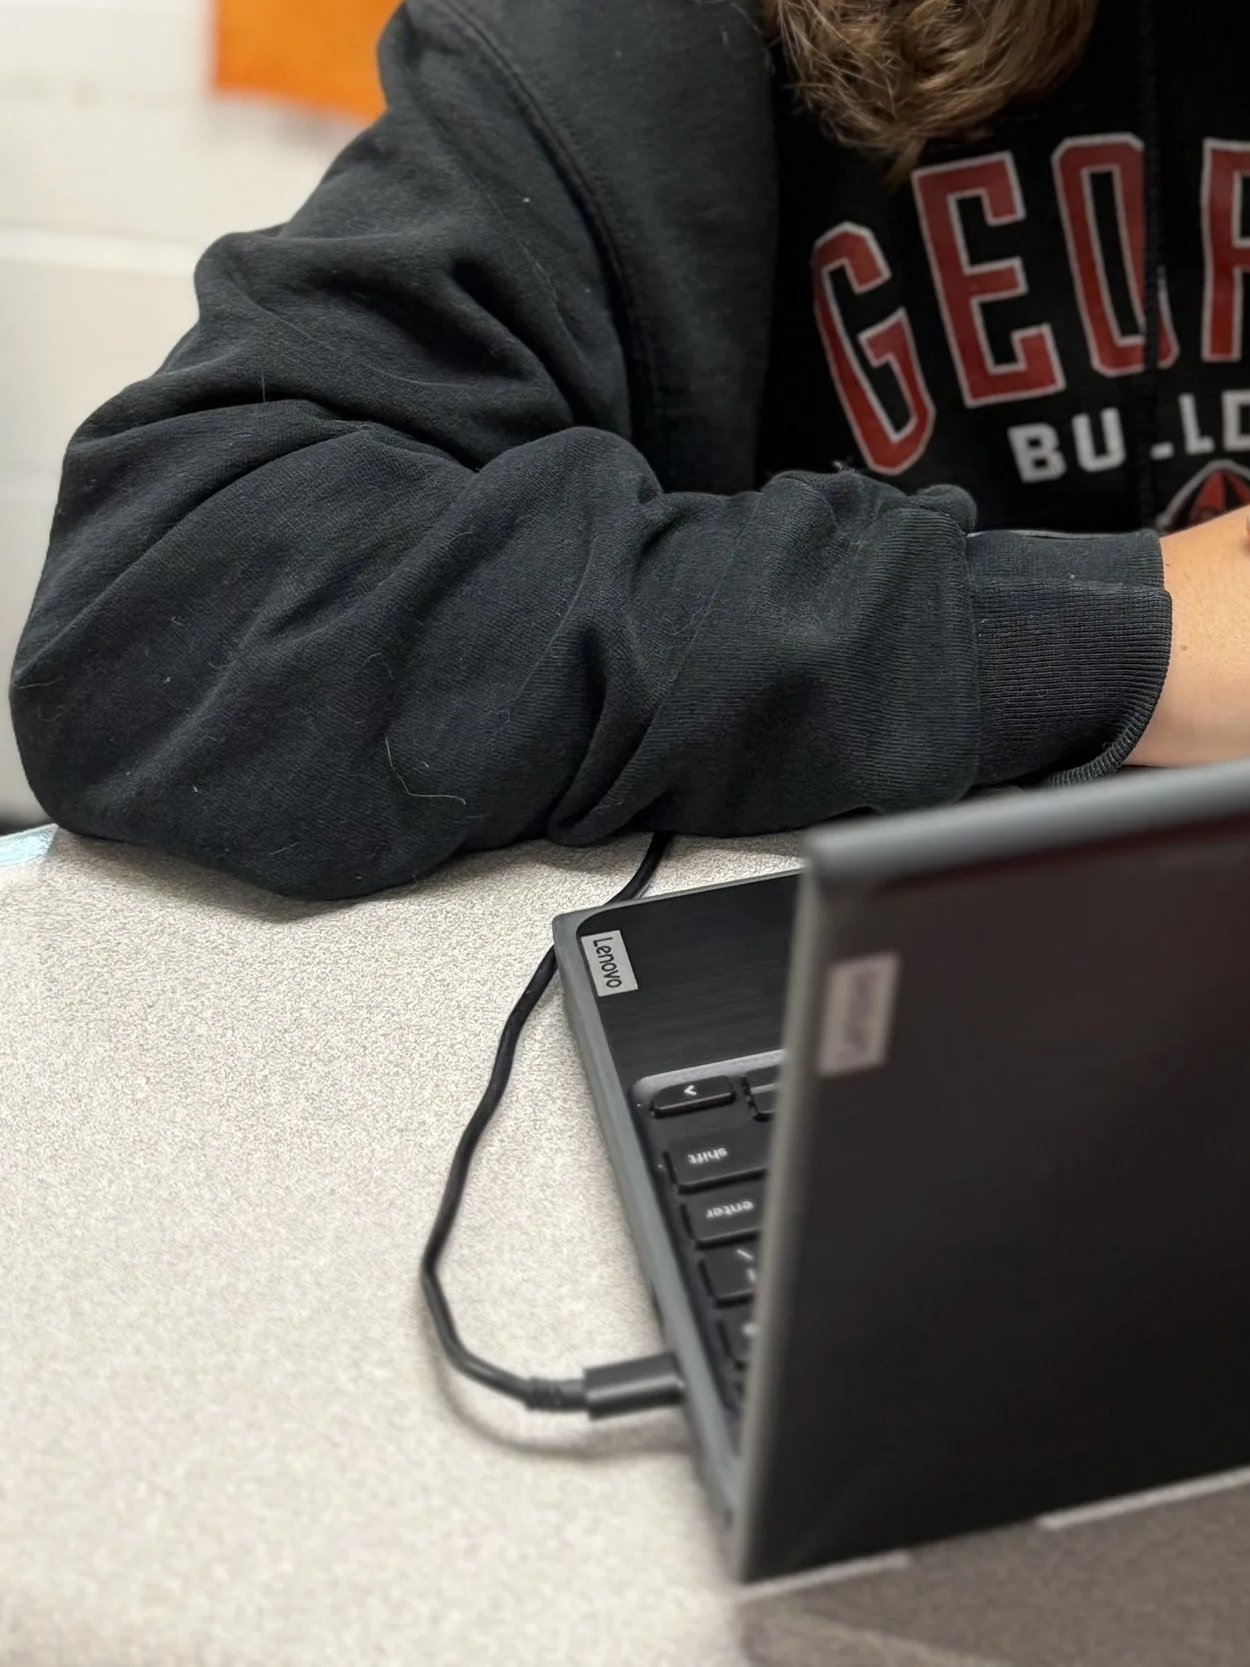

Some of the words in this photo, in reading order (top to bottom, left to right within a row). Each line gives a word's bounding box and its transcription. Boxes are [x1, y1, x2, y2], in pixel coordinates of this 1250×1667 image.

[593, 937, 622, 988] Lenovo
[687, 1146, 728, 1165] shift
[705, 1199, 754, 1219] enter
